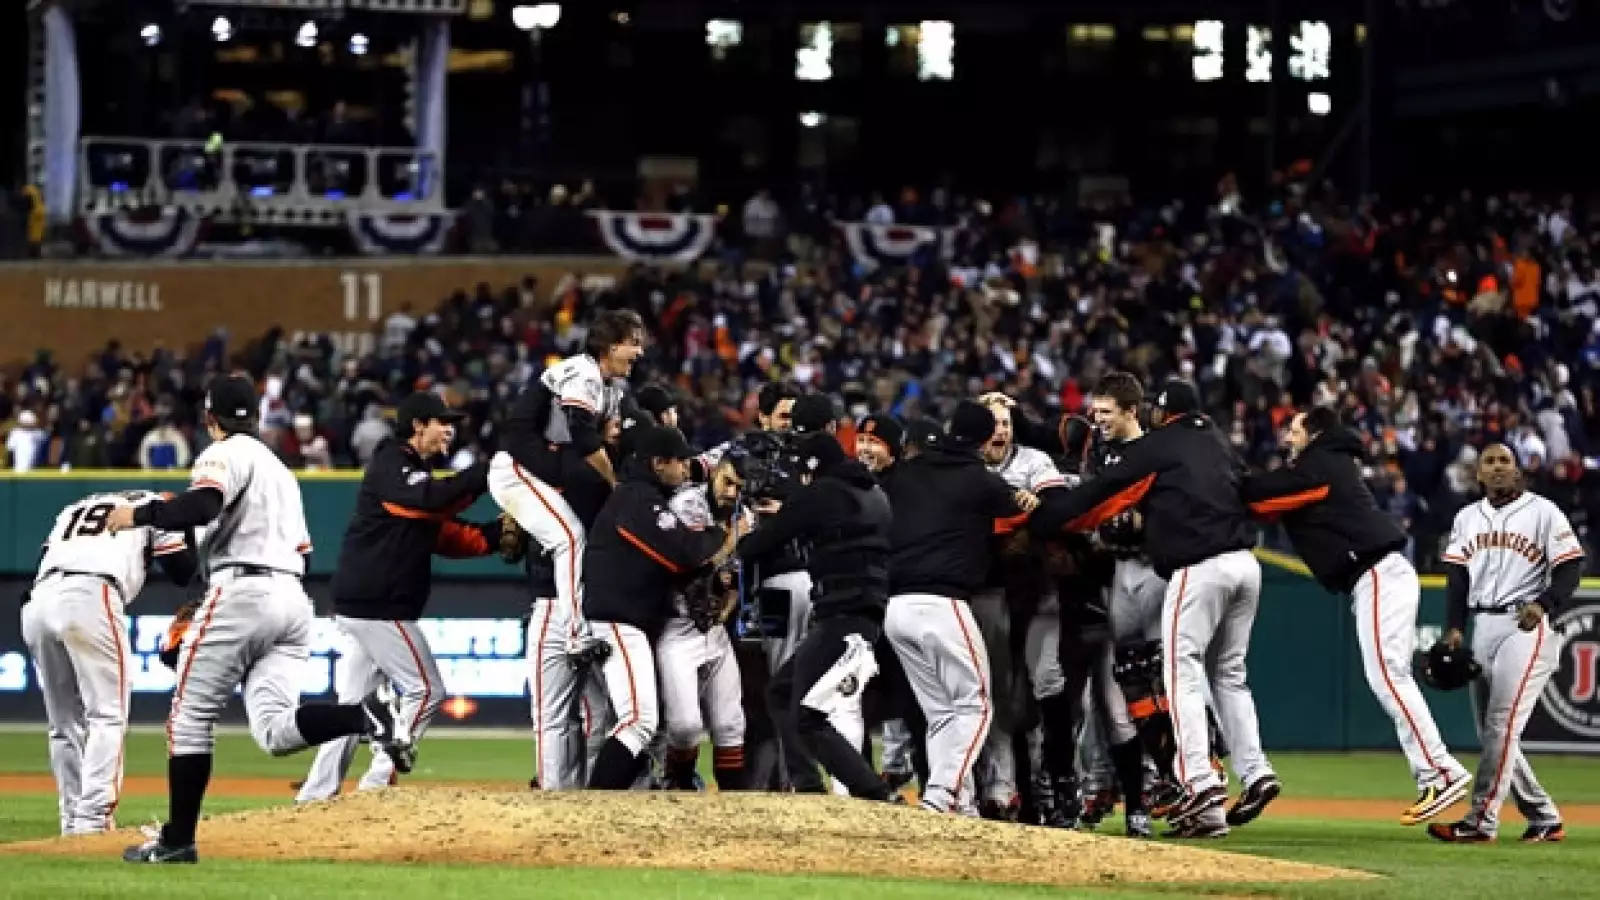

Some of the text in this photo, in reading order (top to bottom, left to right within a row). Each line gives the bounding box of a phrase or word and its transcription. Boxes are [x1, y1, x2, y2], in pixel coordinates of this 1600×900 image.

[45, 279, 162, 311] HARWELL
[340, 272, 382, 320] 11
[61, 502, 116, 541] 19
